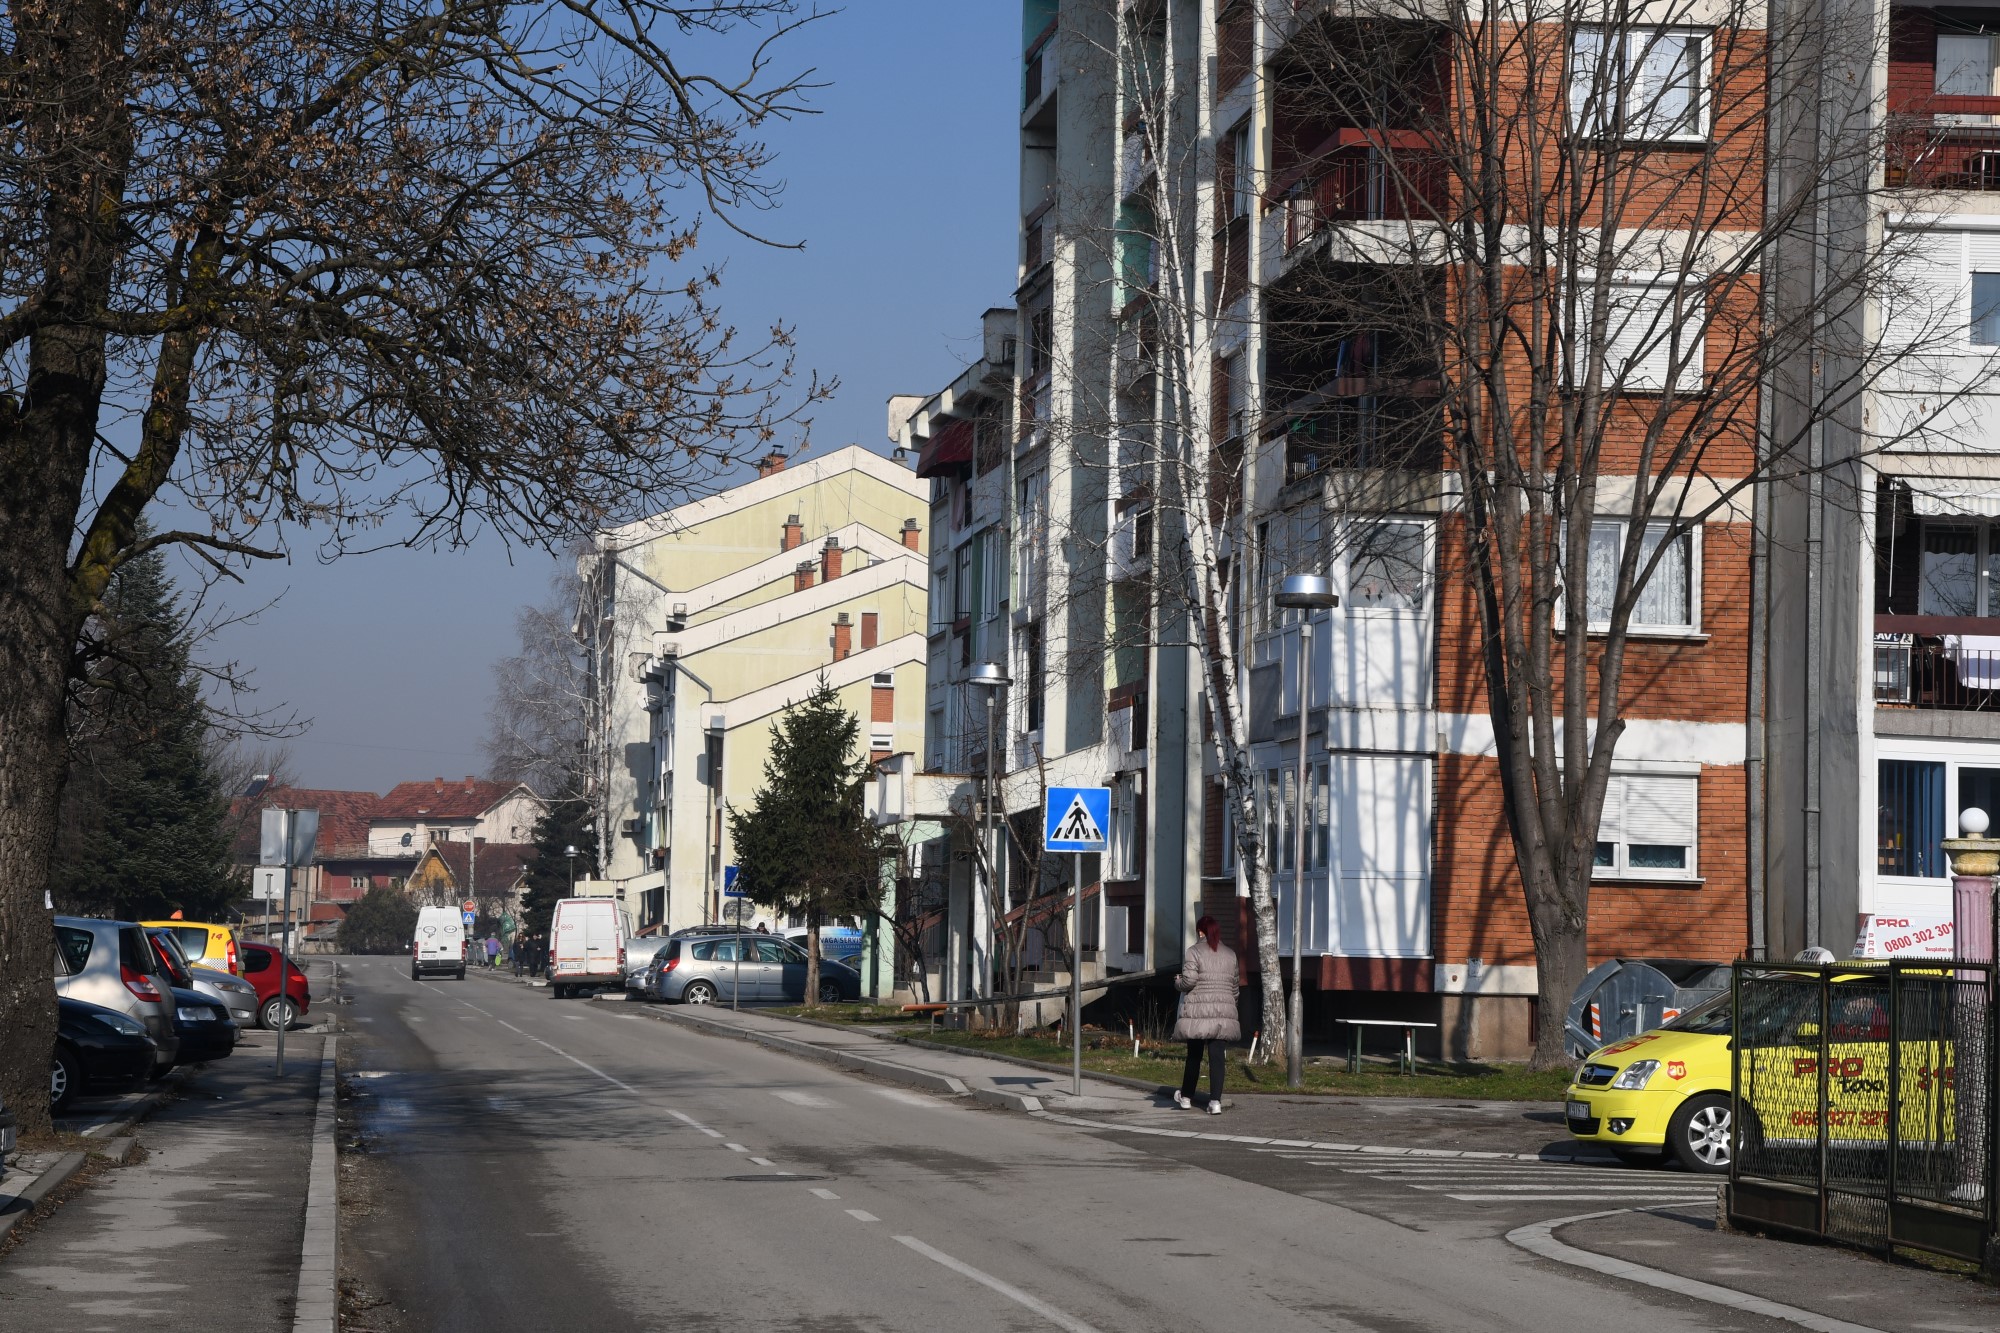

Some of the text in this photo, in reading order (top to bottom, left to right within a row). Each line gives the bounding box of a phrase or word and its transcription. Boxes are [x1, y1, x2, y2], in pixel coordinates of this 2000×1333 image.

[1876, 919, 1909, 927] PRO
[1884, 935, 1912, 952] 0800
[1912, 928, 1935, 943] 302
[1793, 1058, 1864, 1078] PRO
[1838, 1079, 1885, 1093] taxi
